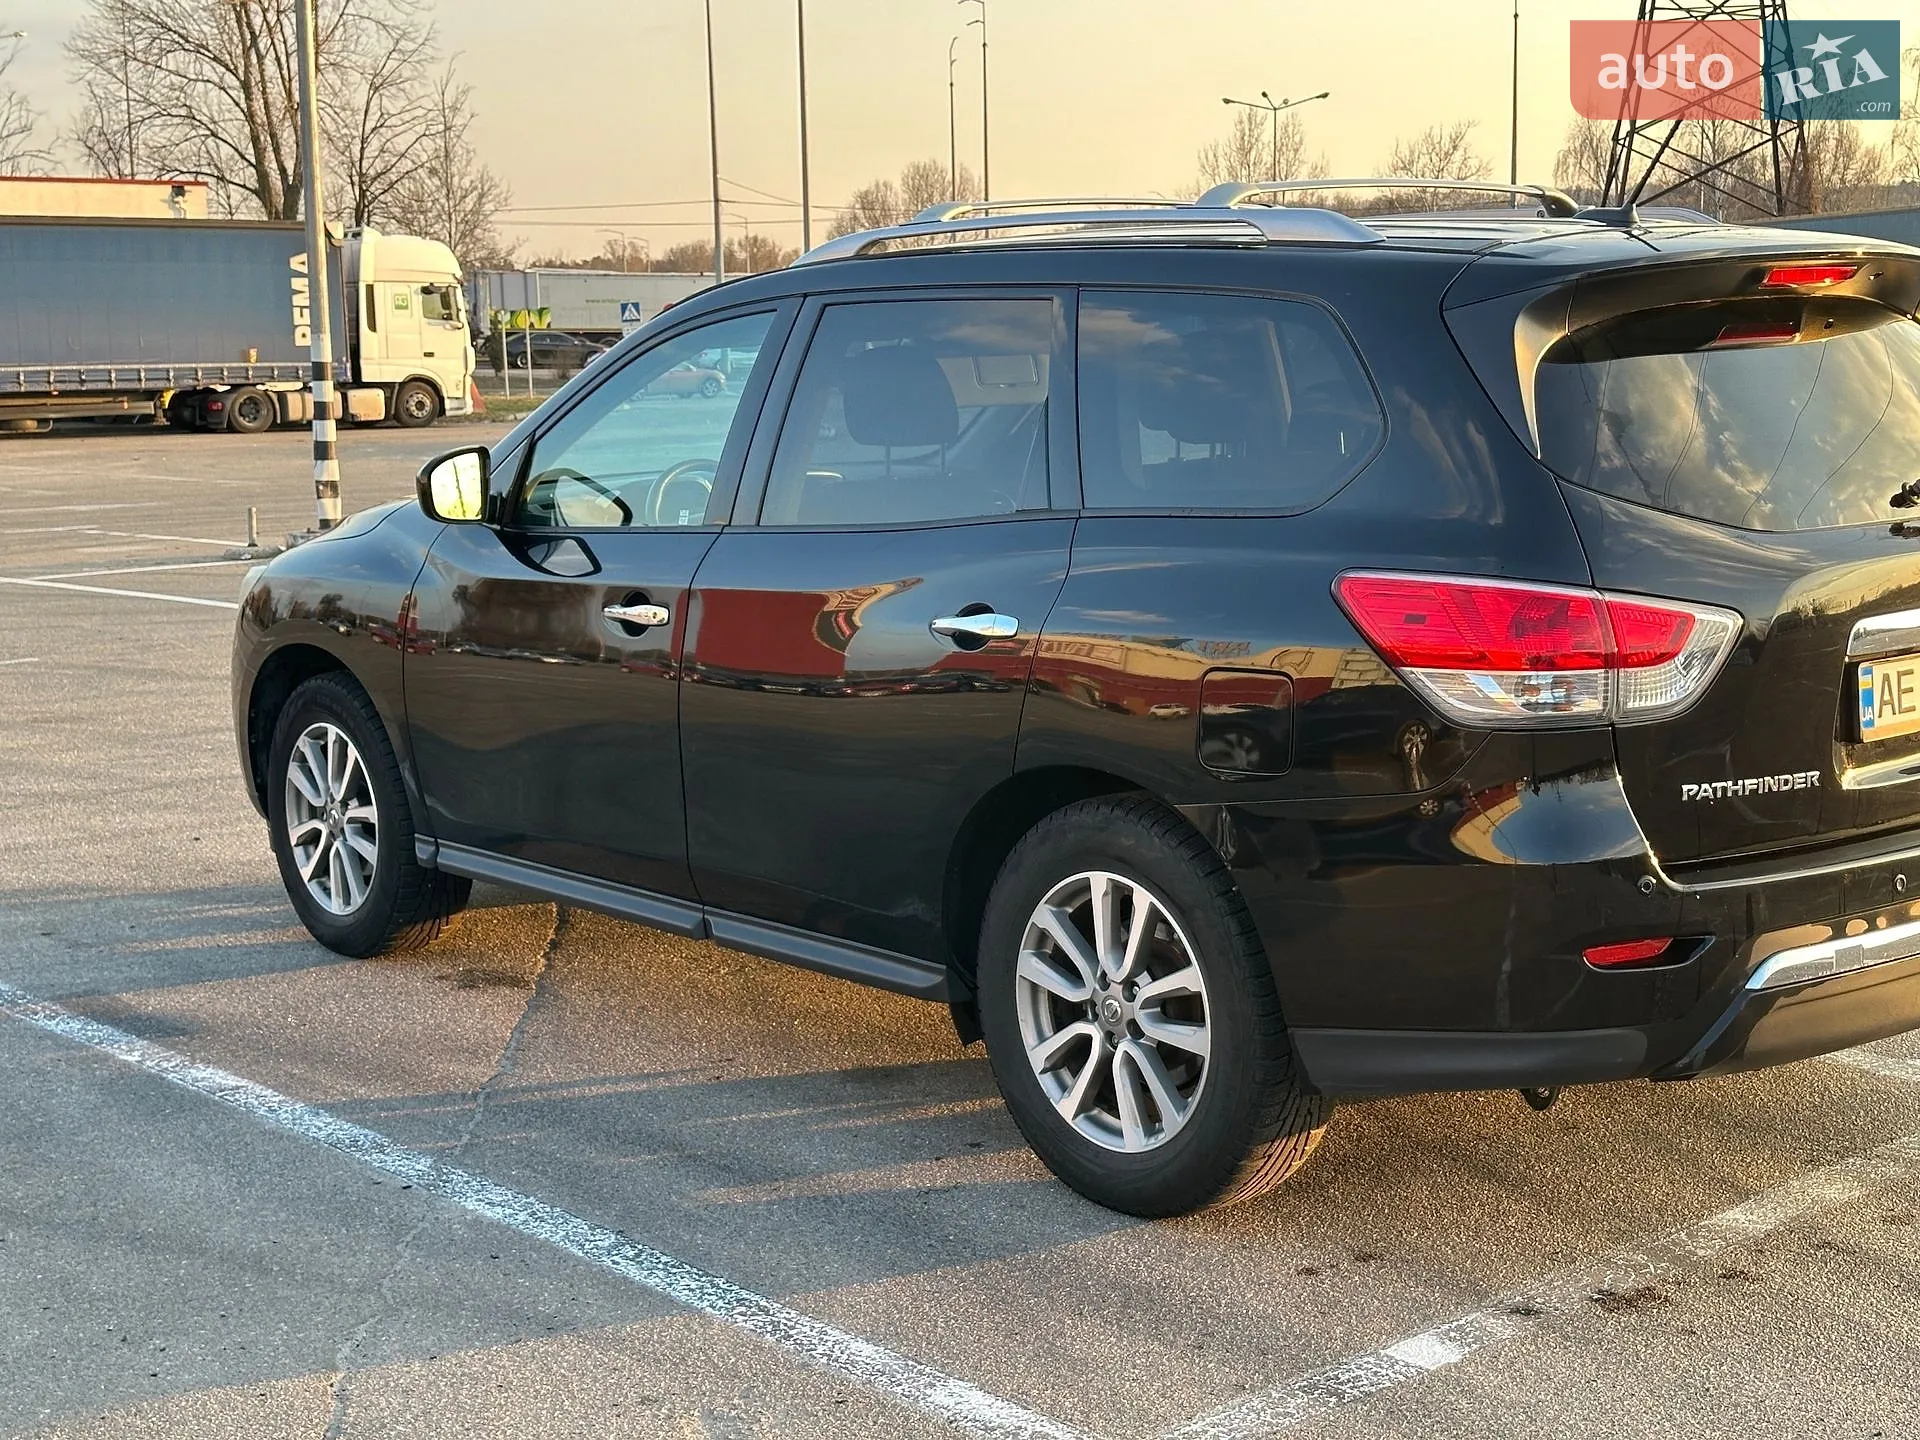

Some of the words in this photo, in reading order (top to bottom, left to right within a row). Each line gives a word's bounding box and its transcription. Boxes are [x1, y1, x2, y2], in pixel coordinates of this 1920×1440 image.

[1877, 669, 1917, 719] AE
[1861, 706, 1874, 722] UA
[1681, 770, 1821, 801] PATHFINDER
